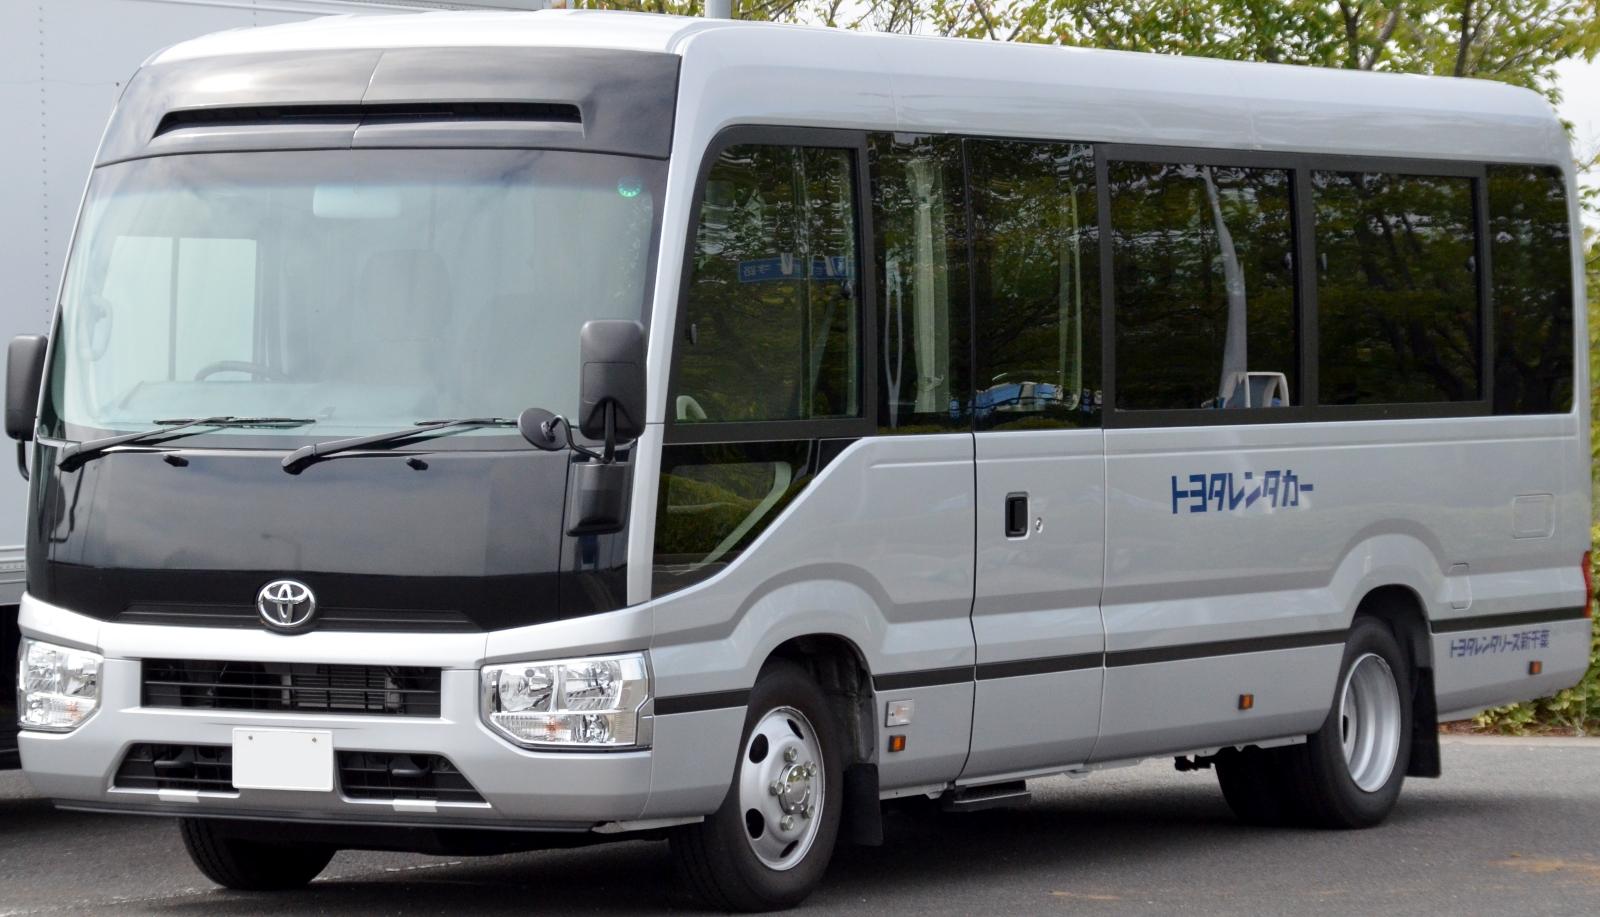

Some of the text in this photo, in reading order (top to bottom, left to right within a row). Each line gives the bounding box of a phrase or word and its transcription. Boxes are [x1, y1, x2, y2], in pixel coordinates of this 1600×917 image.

[1172, 470, 1313, 514] トヨタレンタカー
[1449, 630, 1550, 658] トヨタレンタリース新千葉
